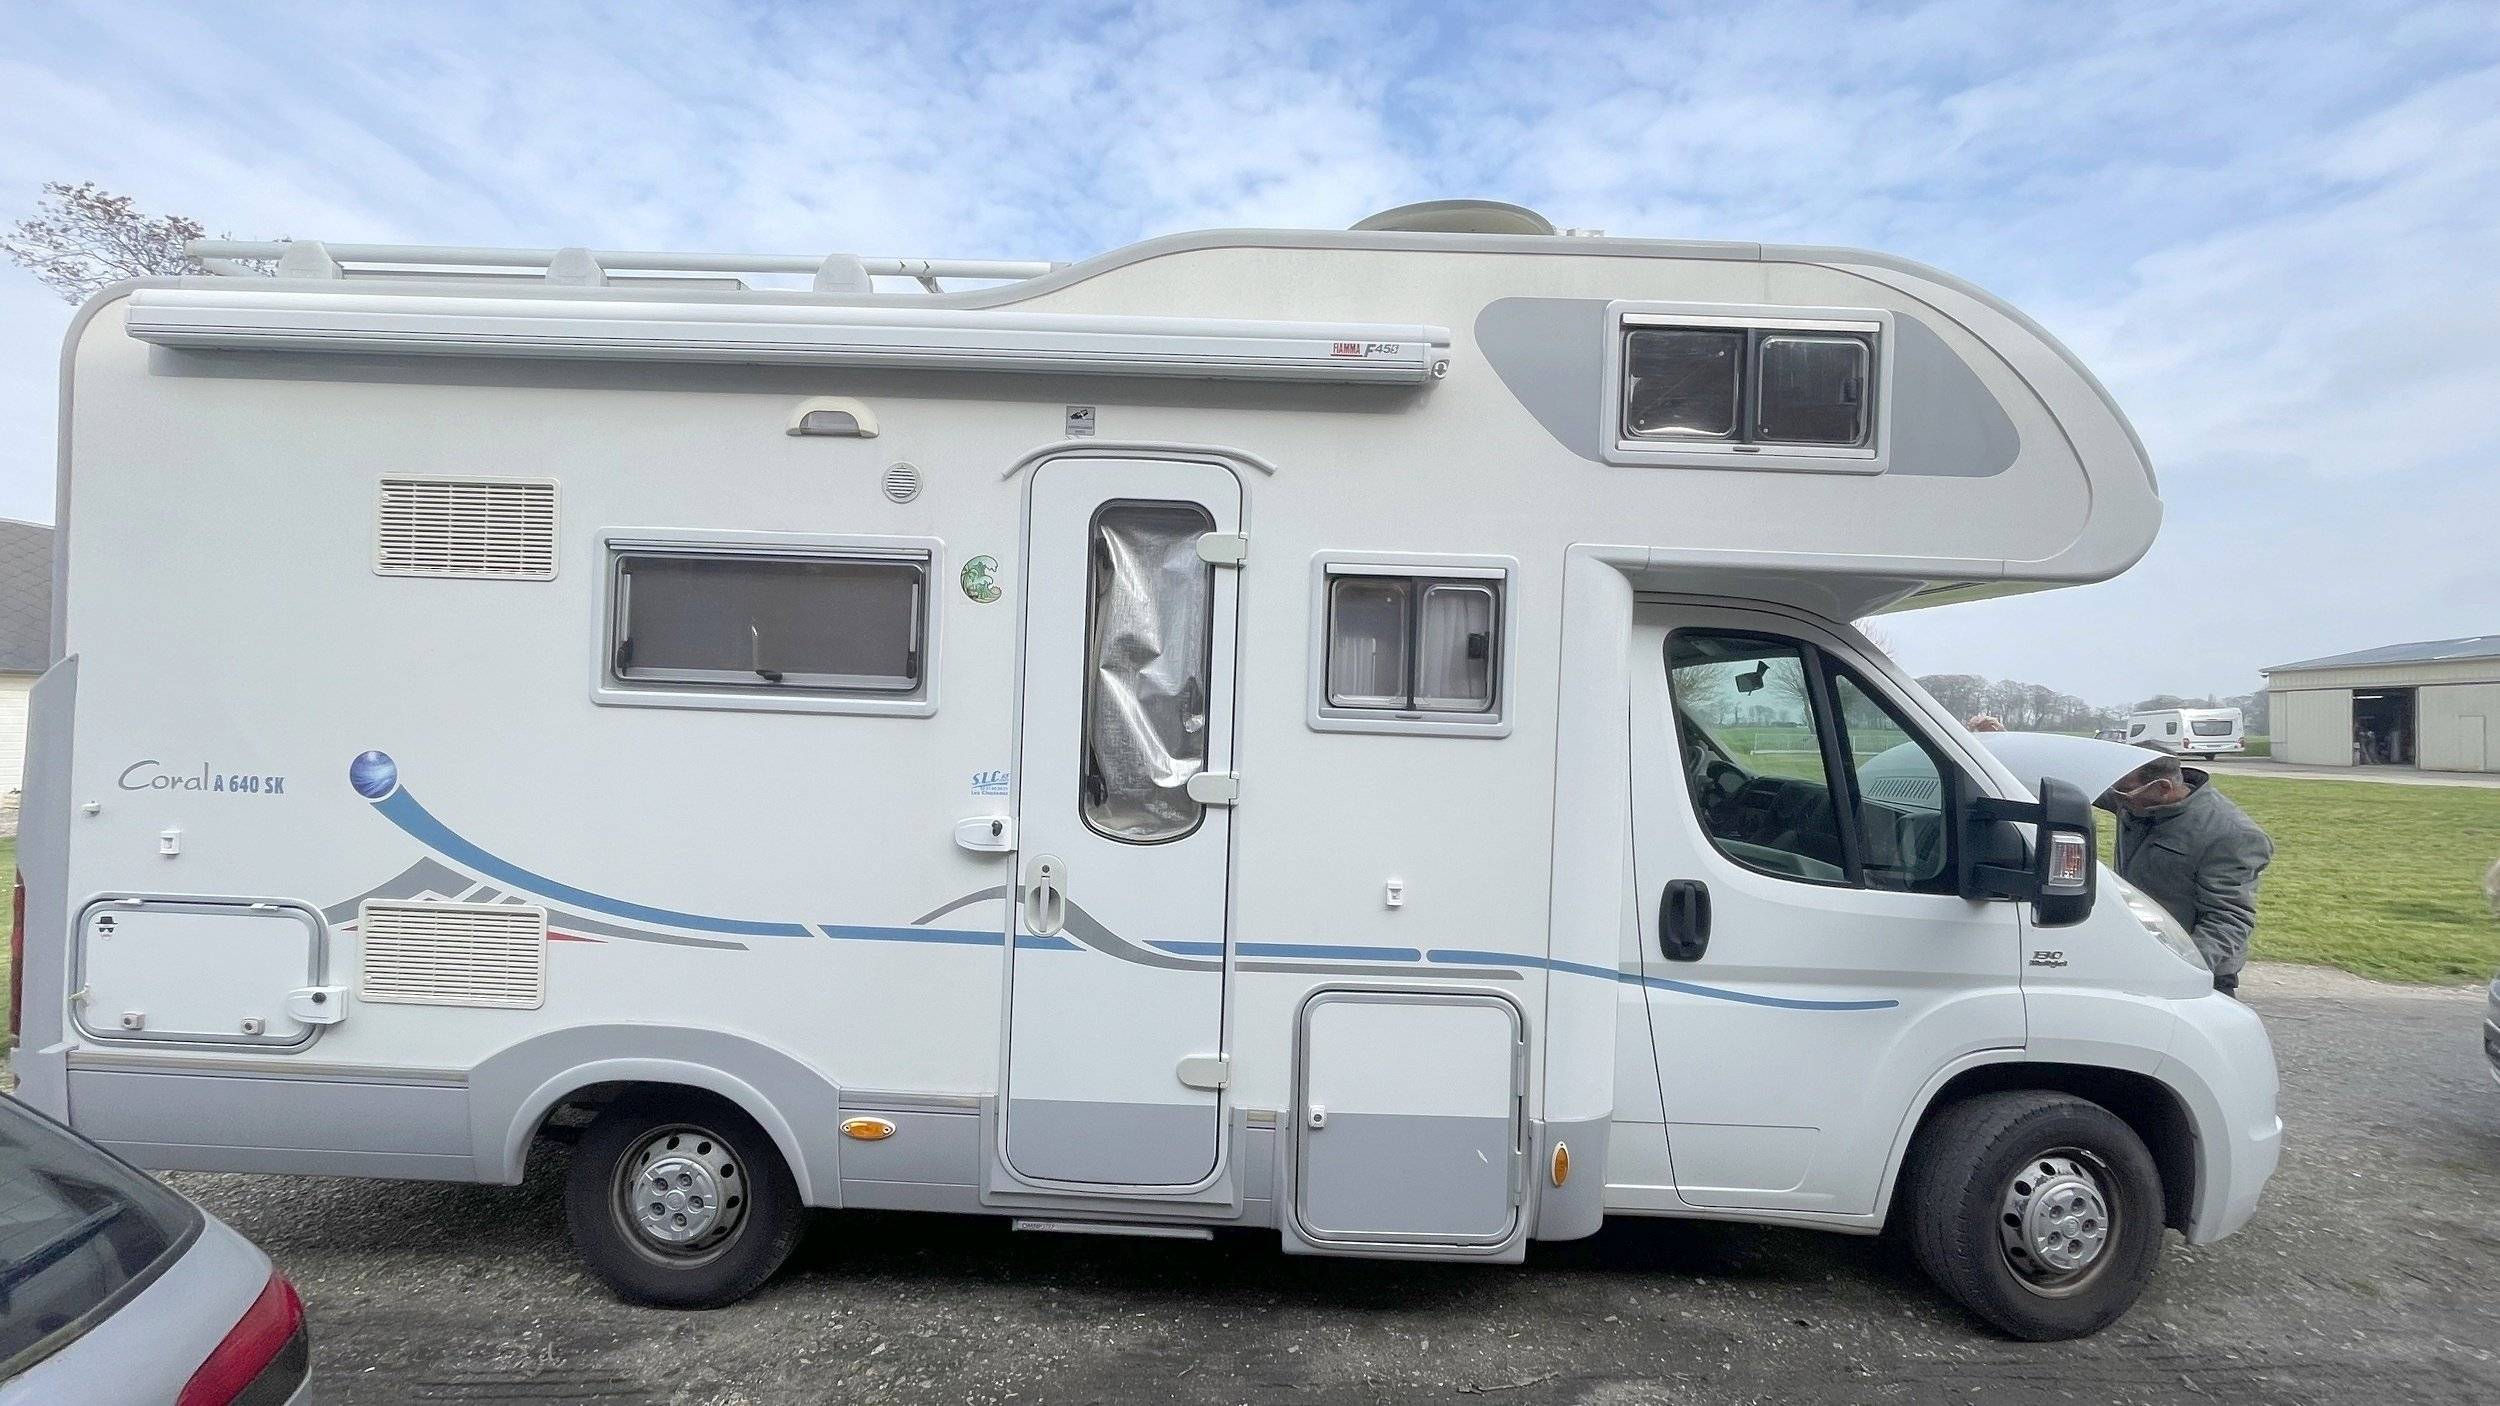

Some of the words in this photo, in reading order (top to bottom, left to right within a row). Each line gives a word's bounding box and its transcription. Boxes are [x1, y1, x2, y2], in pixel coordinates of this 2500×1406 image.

[1333, 342, 1361, 355] FIAMMA
[117, 759, 210, 792] Coral
[213, 774, 224, 792] A
[229, 774, 260, 793] 640
[264, 776, 285, 794] SK
[2032, 951, 2064, 960] 130
